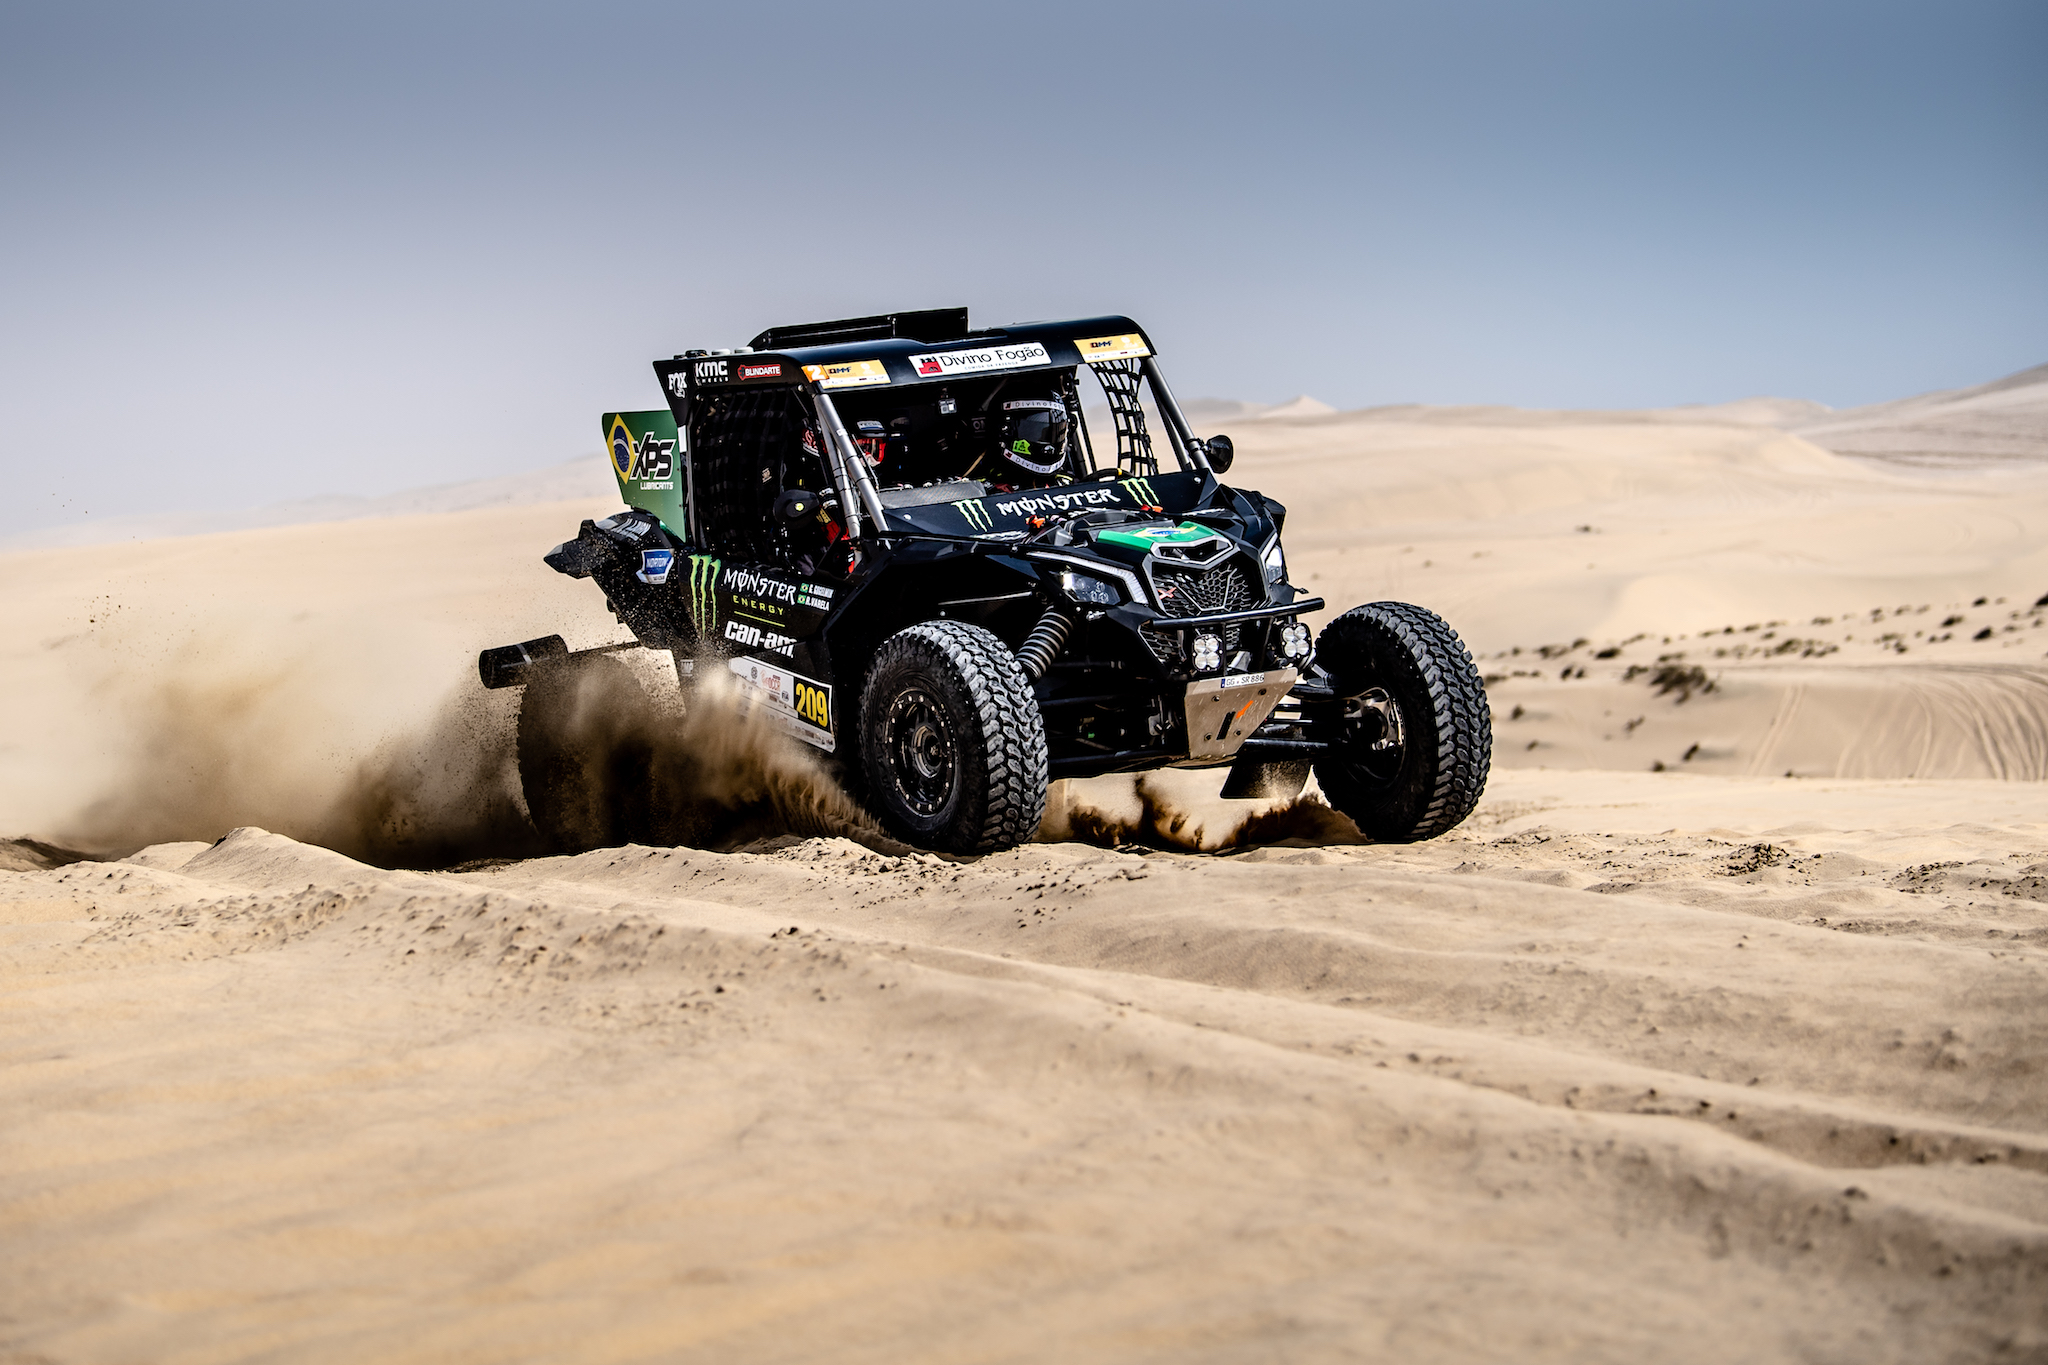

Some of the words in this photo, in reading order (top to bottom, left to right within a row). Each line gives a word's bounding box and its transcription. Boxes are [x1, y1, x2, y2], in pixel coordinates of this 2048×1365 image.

[939, 353, 992, 367] Divino
[994, 347, 1045, 361] Fogão
[695, 361, 728, 378] KMC
[744, 366, 781, 376] BLINDARTE
[807, 365, 825, 381] 2
[668, 372, 688, 397] FOX
[630, 431, 677, 480] XPS
[640, 482, 674, 490] LUBRICANTS
[996, 488, 1121, 517] MONSTER
[723, 568, 796, 606] MONSTER
[733, 595, 784, 616] ENERGY
[724, 620, 797, 659] can-am
[1226, 678, 1236, 686] GG
[795, 683, 828, 727] 209
